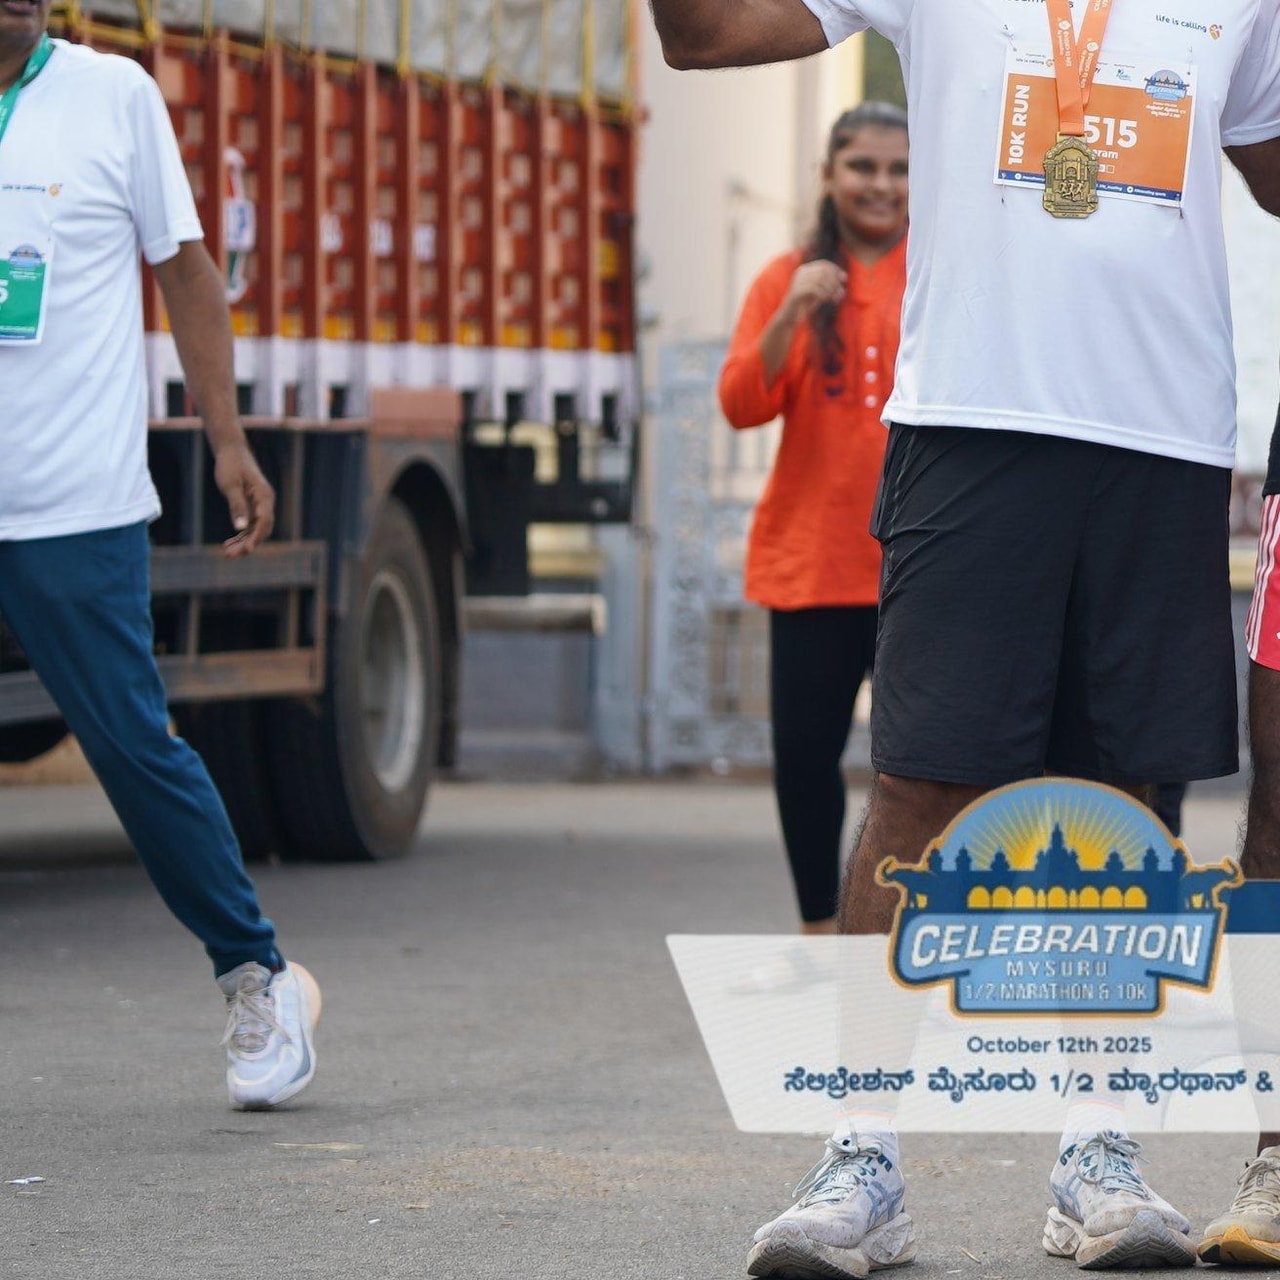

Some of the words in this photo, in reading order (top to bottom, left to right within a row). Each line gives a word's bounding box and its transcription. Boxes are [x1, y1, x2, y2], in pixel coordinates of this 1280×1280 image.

[1156, 15, 1170, 24] life
[1172, 17, 1180, 26] is
[1181, 20, 1207, 33] calling
[1012, 84, 1030, 127] RUN
[1008, 132, 1024, 165] 10K
